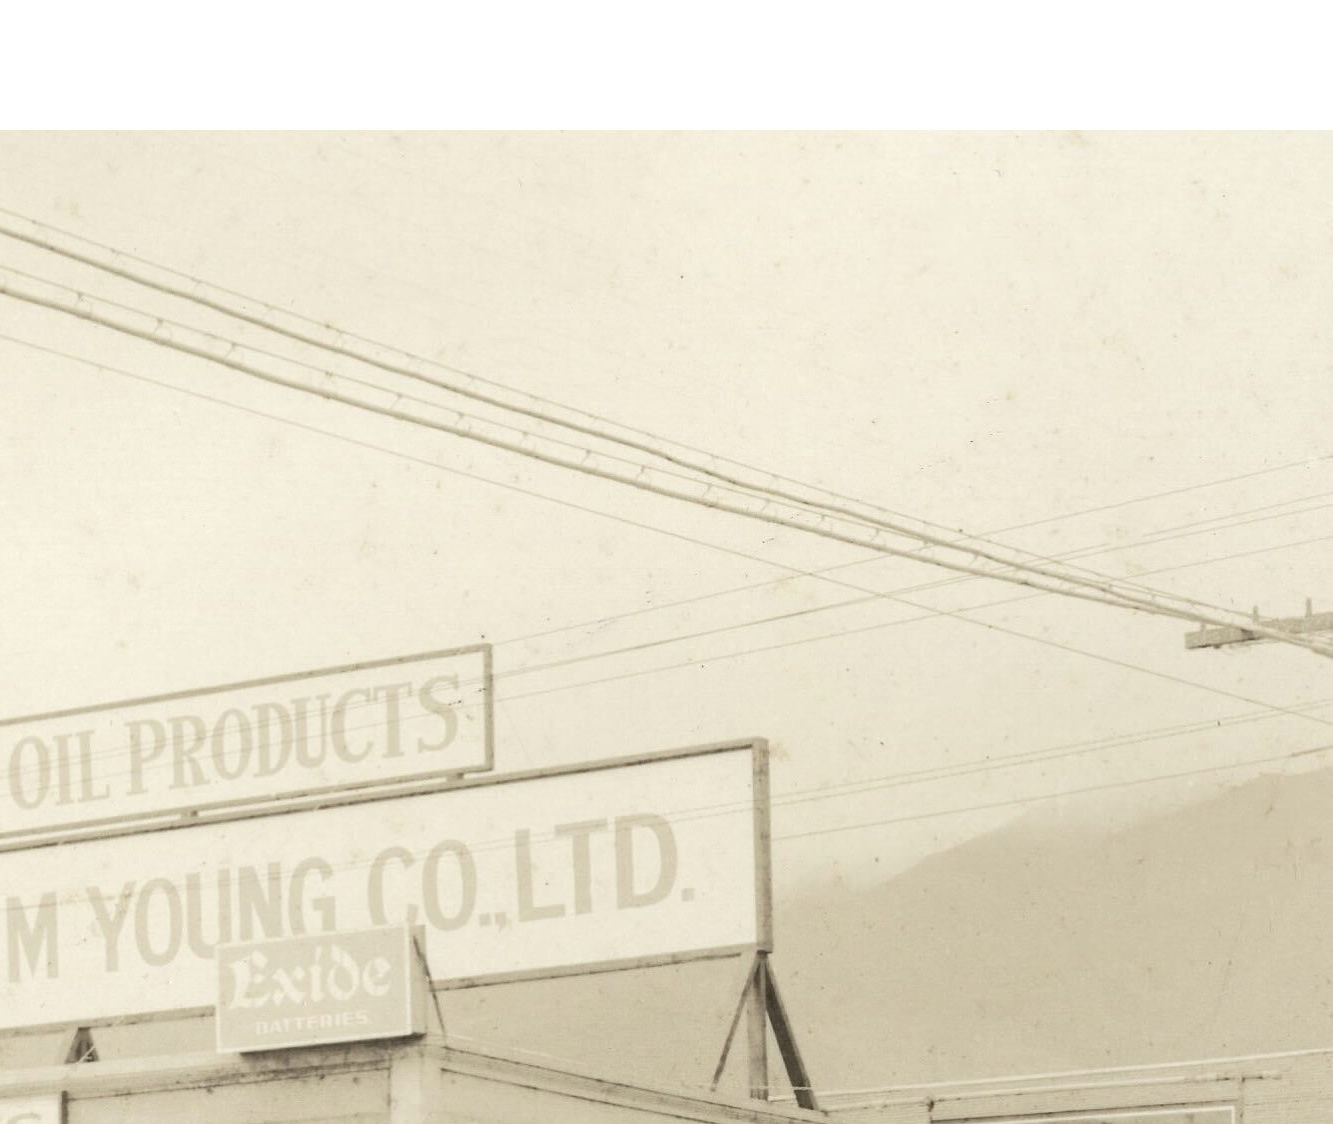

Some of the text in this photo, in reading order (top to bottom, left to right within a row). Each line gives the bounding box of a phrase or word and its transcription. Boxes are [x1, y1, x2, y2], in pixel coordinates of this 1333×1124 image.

[7, 728, 111, 811] OIL
[123, 671, 461, 797] PRODUCTS
[87, 856, 337, 973] YOUNG
[228, 944, 392, 1010] Exide
[255, 1009, 369, 1036] BATTERIES
